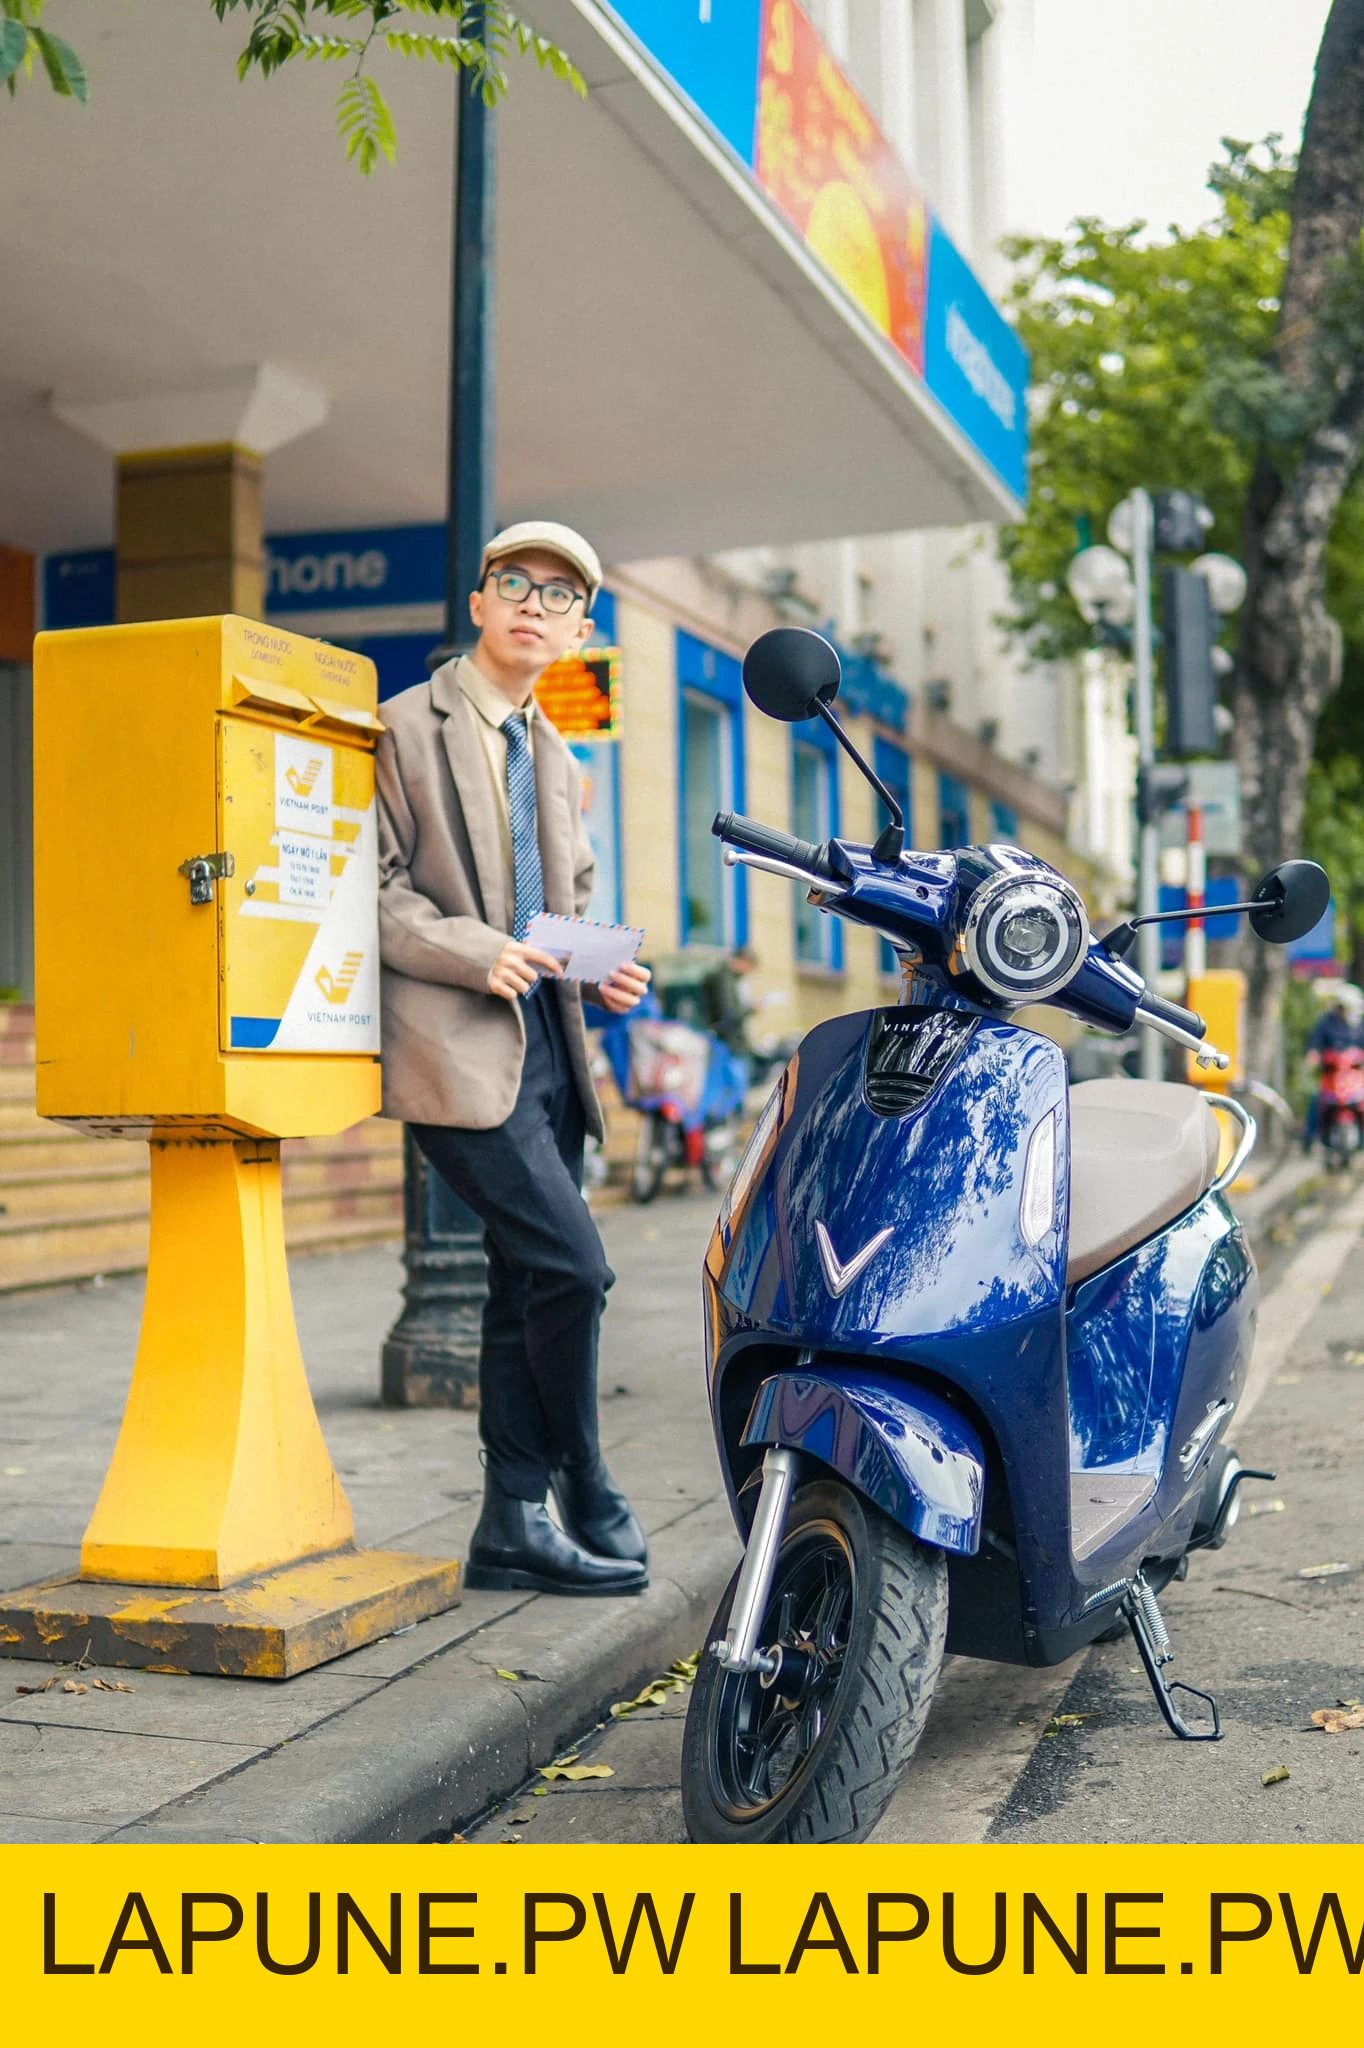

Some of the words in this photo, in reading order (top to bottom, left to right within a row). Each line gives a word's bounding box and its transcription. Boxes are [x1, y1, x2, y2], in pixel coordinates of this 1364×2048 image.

[280, 797, 310, 810] VIETNAM
[311, 803, 329, 816] POST
[307, 1011, 346, 1024] VIETNAM
[349, 1013, 371, 1025] POST
[883, 1023, 955, 1038] VINFAST
